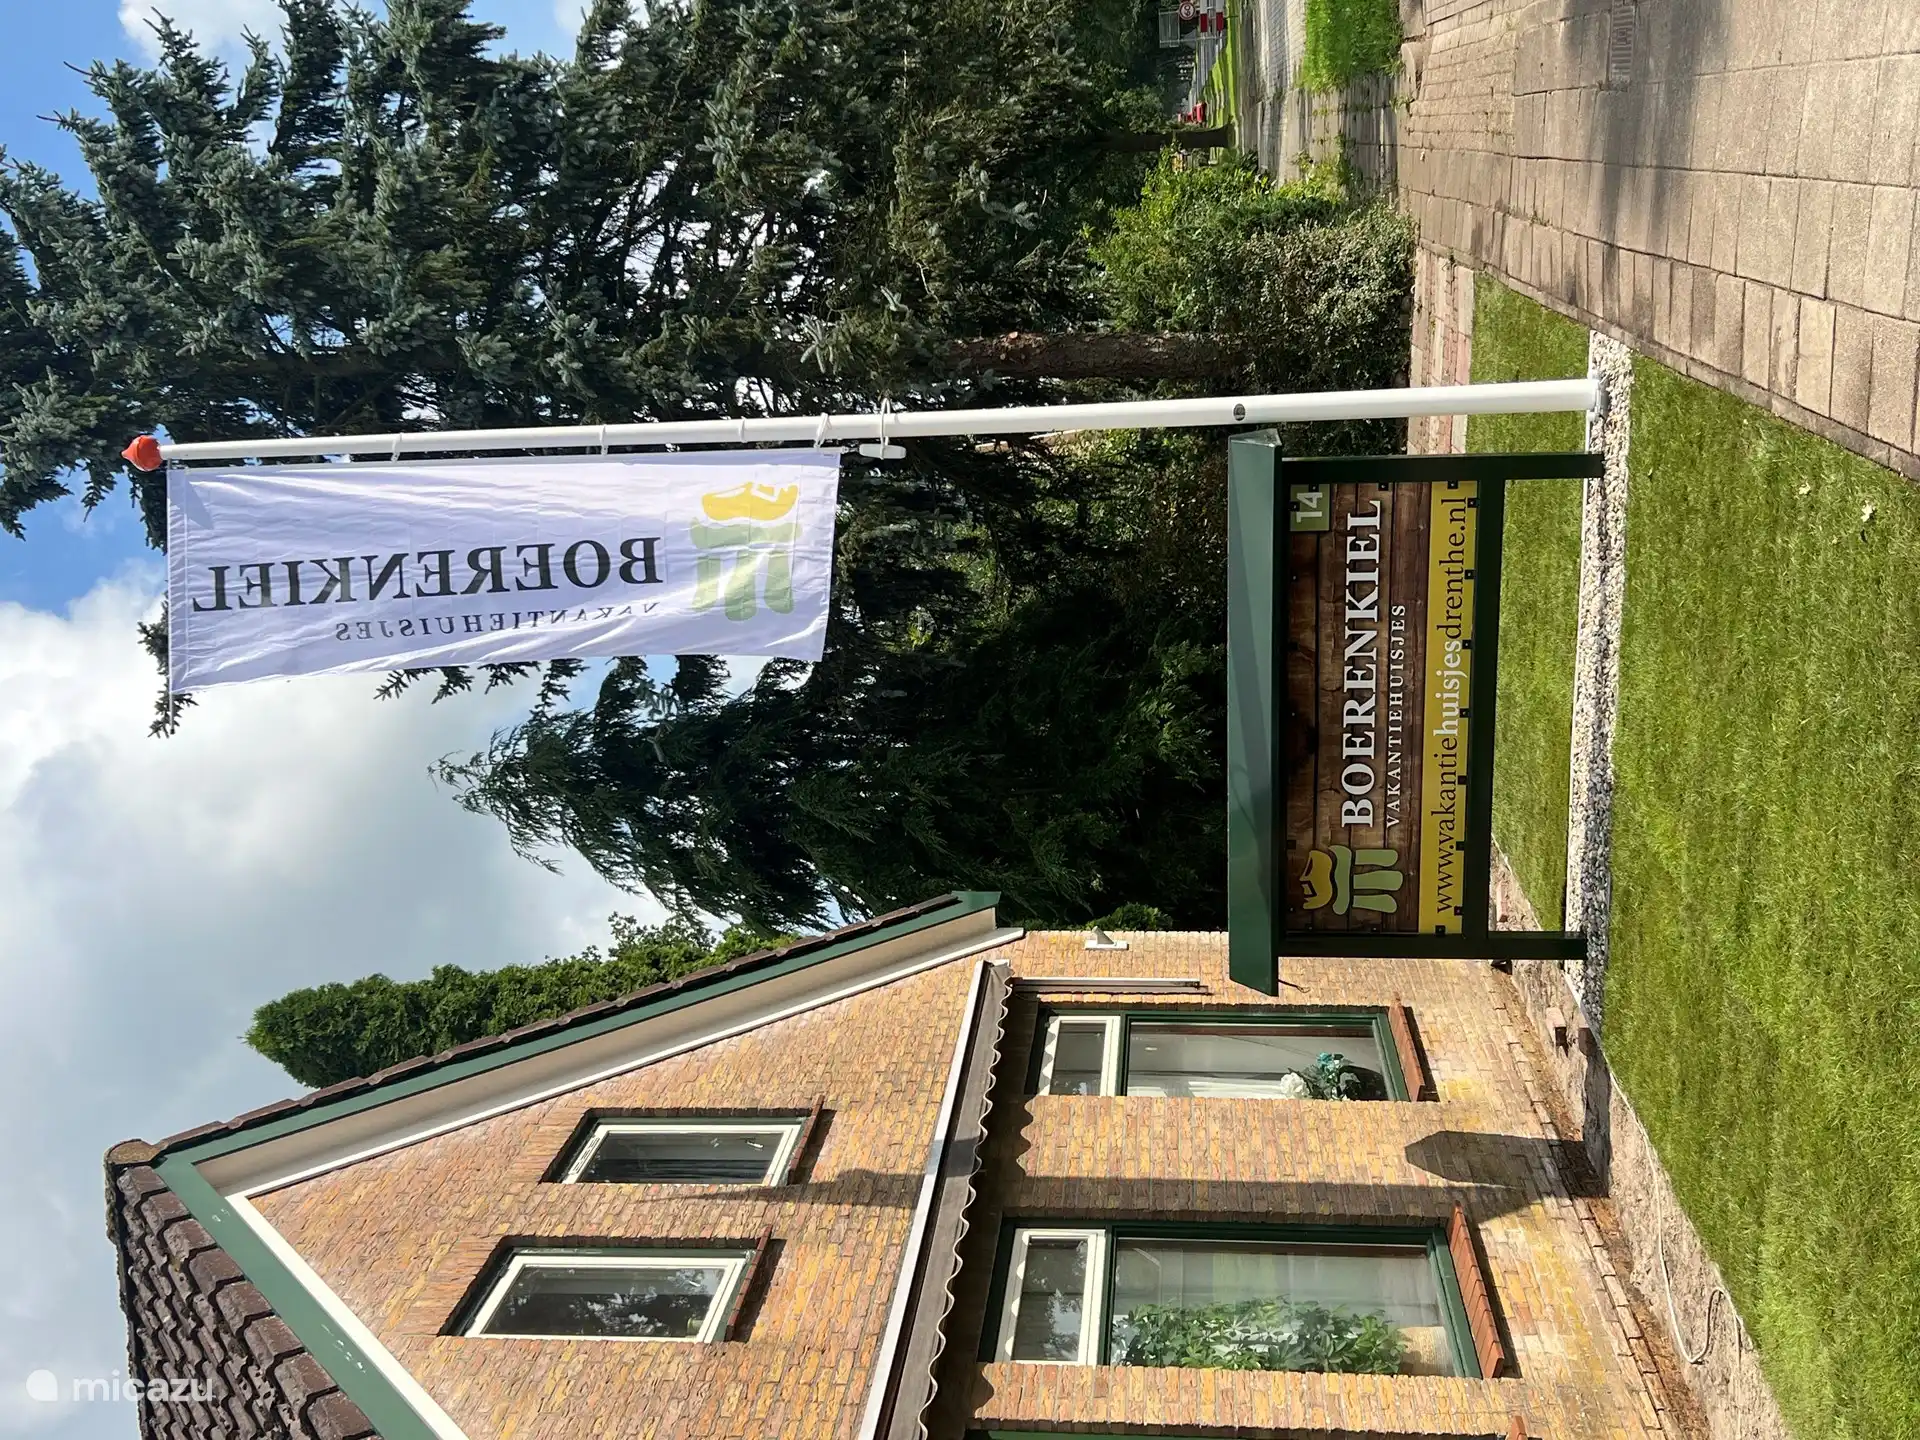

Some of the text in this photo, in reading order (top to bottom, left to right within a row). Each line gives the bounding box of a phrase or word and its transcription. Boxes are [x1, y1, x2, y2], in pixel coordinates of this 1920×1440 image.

[1184, 5, 1191, 16] 60
[1296, 491, 1324, 524] 14
[1342, 499, 1382, 828] BOERENKIEL
[1386, 603, 1407, 828] VAKANTIEHUISJES
[1432, 497, 1468, 912] www.vakantiehuisjesdrenthe.nl
